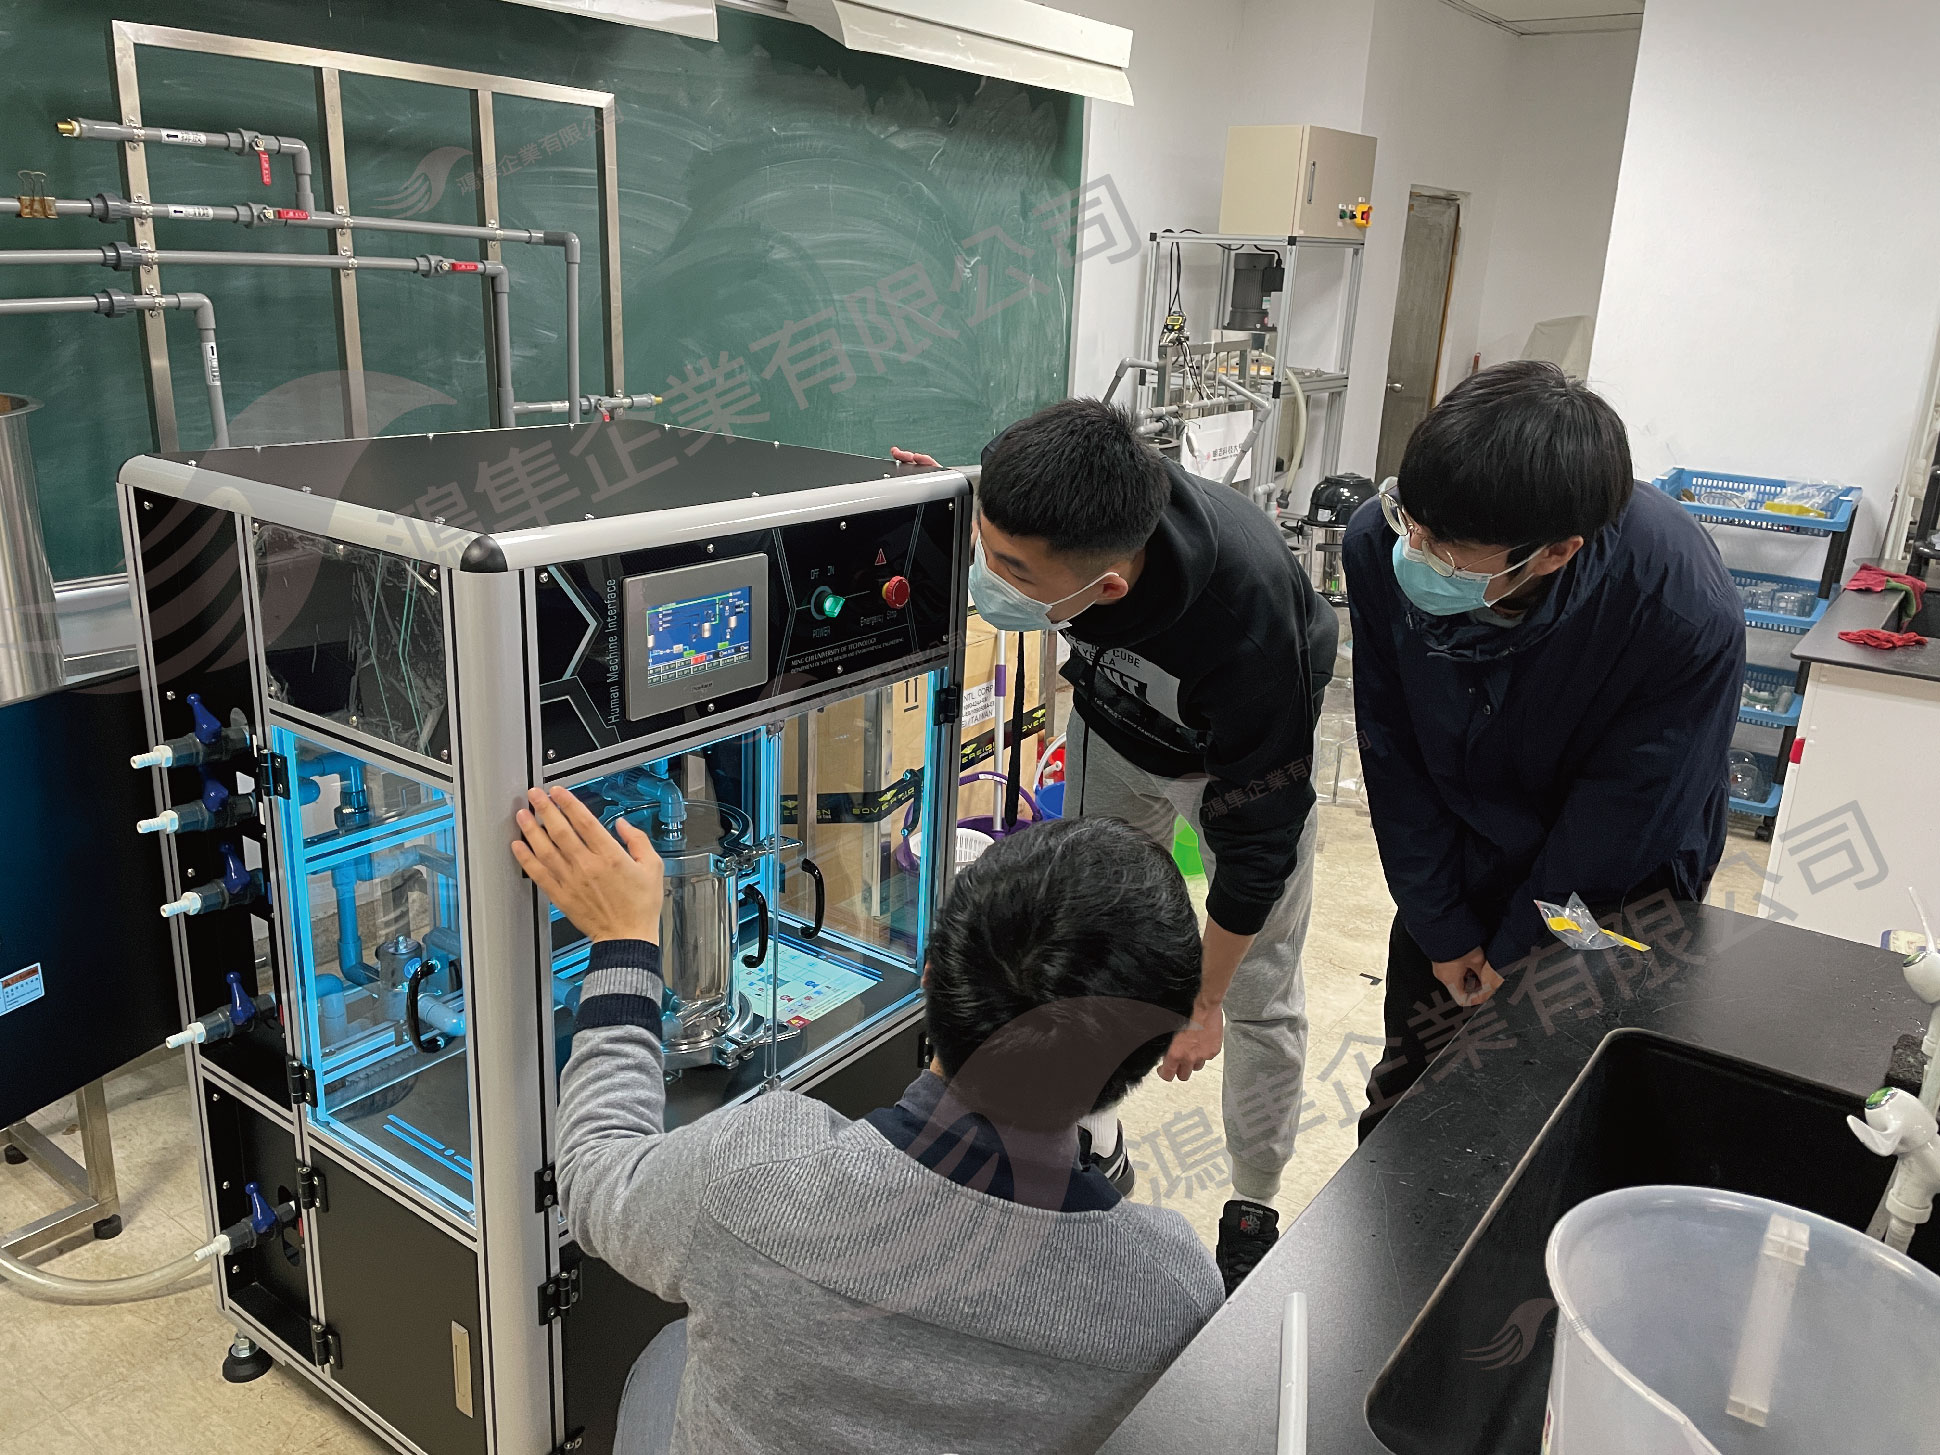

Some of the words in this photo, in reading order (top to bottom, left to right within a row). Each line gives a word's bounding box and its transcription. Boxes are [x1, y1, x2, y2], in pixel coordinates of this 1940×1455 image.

[604, 578, 617, 633] Interface
[812, 625, 831, 639] POWER
[606, 634, 619, 683] Machine
[1082, 648, 1116, 667] YELA
[1113, 649, 1141, 668] CUBE
[608, 685, 620, 724] Human
